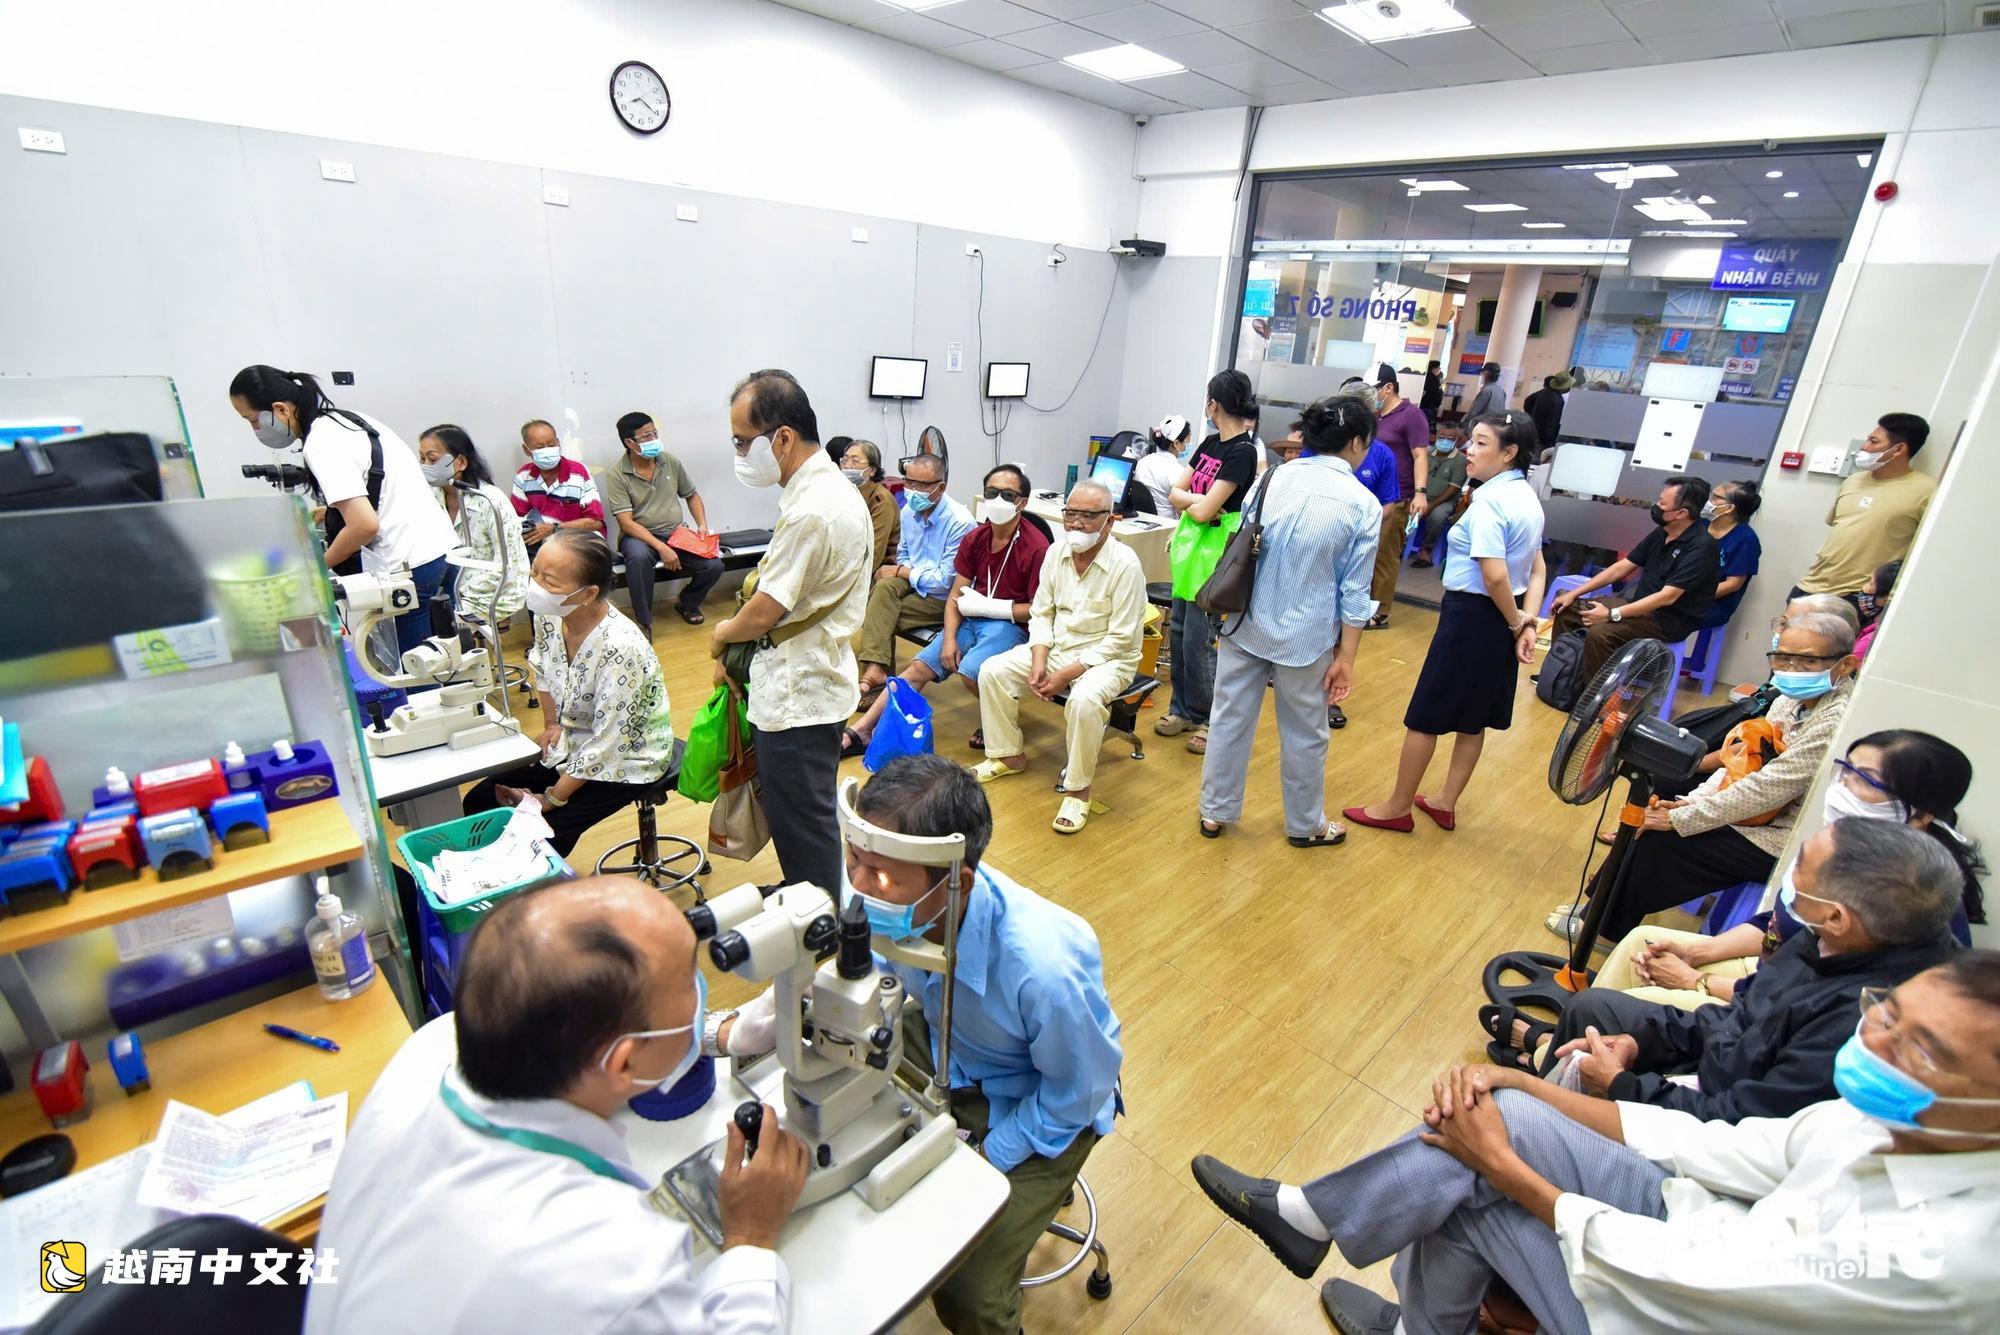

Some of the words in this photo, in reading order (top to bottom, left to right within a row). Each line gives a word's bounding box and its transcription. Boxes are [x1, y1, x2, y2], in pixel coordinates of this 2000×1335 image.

[633, 71, 642, 80] 12
[617, 91, 623, 99] 9
[1720, 267, 1768, 287] NHẬN
[1770, 268, 1820, 288] BỆNH
[1669, 332, 1683, 348] F
[1195, 453, 1223, 477] THE
